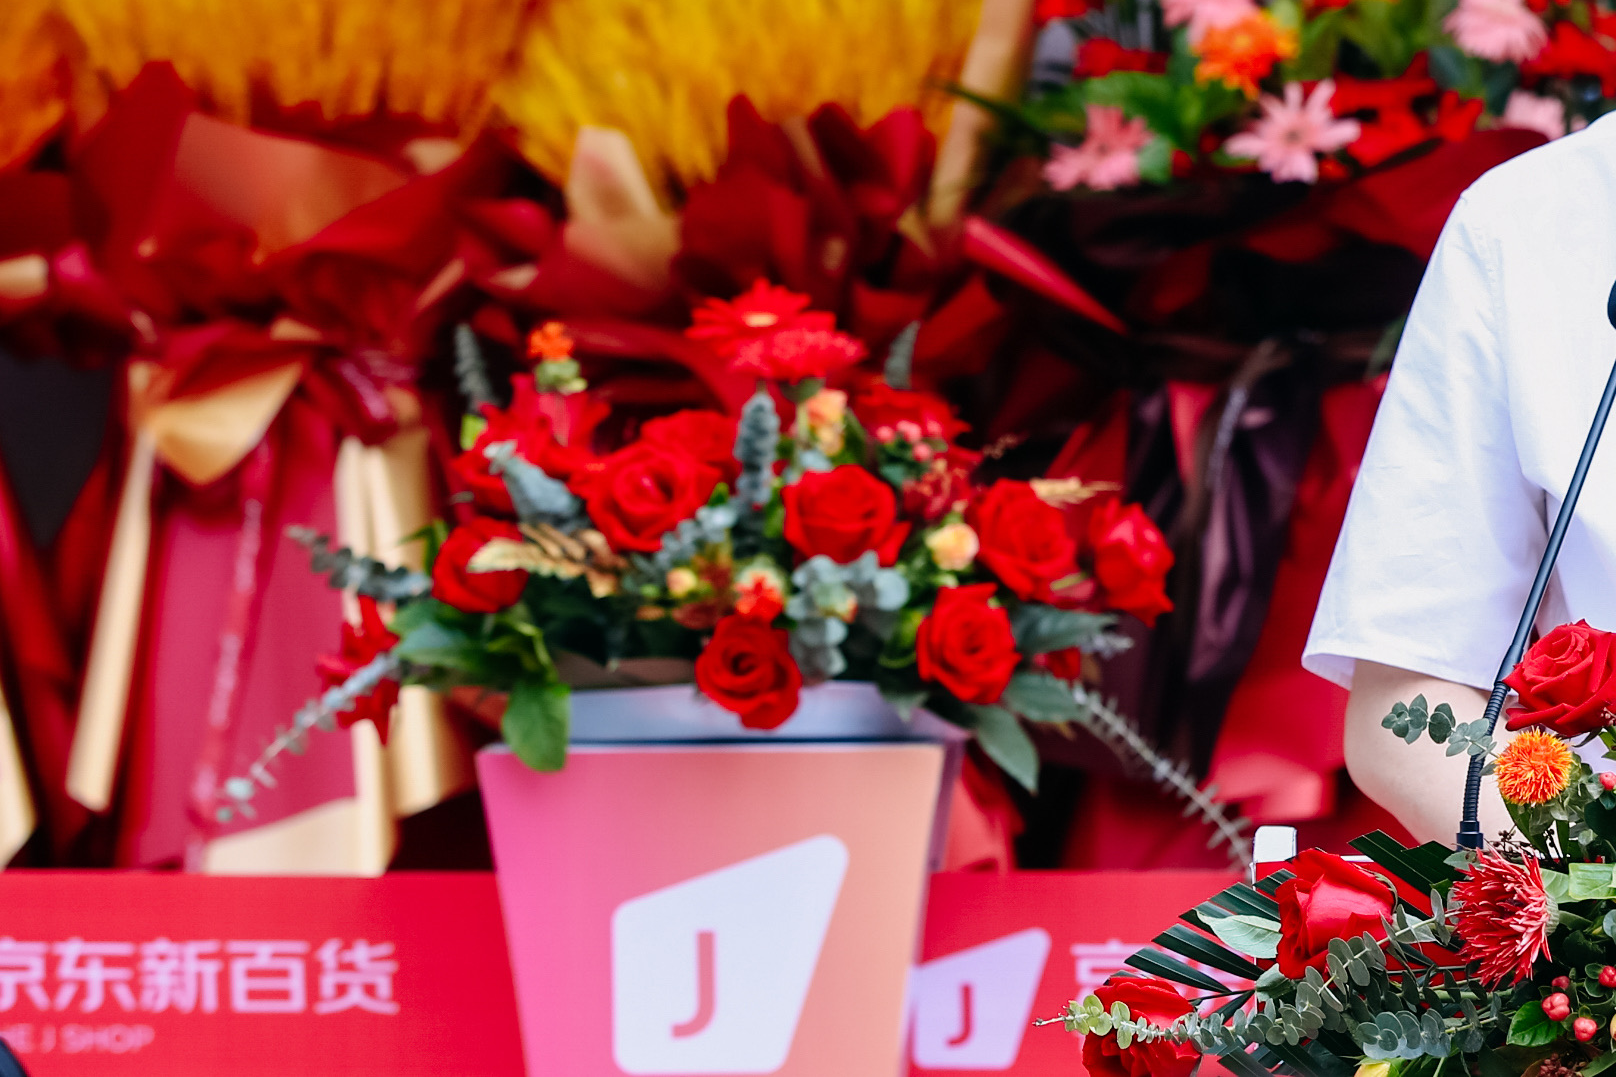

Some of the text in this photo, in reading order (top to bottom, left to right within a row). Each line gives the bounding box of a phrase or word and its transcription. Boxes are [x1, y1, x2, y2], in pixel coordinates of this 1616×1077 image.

[0, 937, 400, 1015] 京东新百货
[670, 930, 716, 1039] J
[61, 1024, 156, 1054] SHOP
[944, 984, 975, 1047] J
